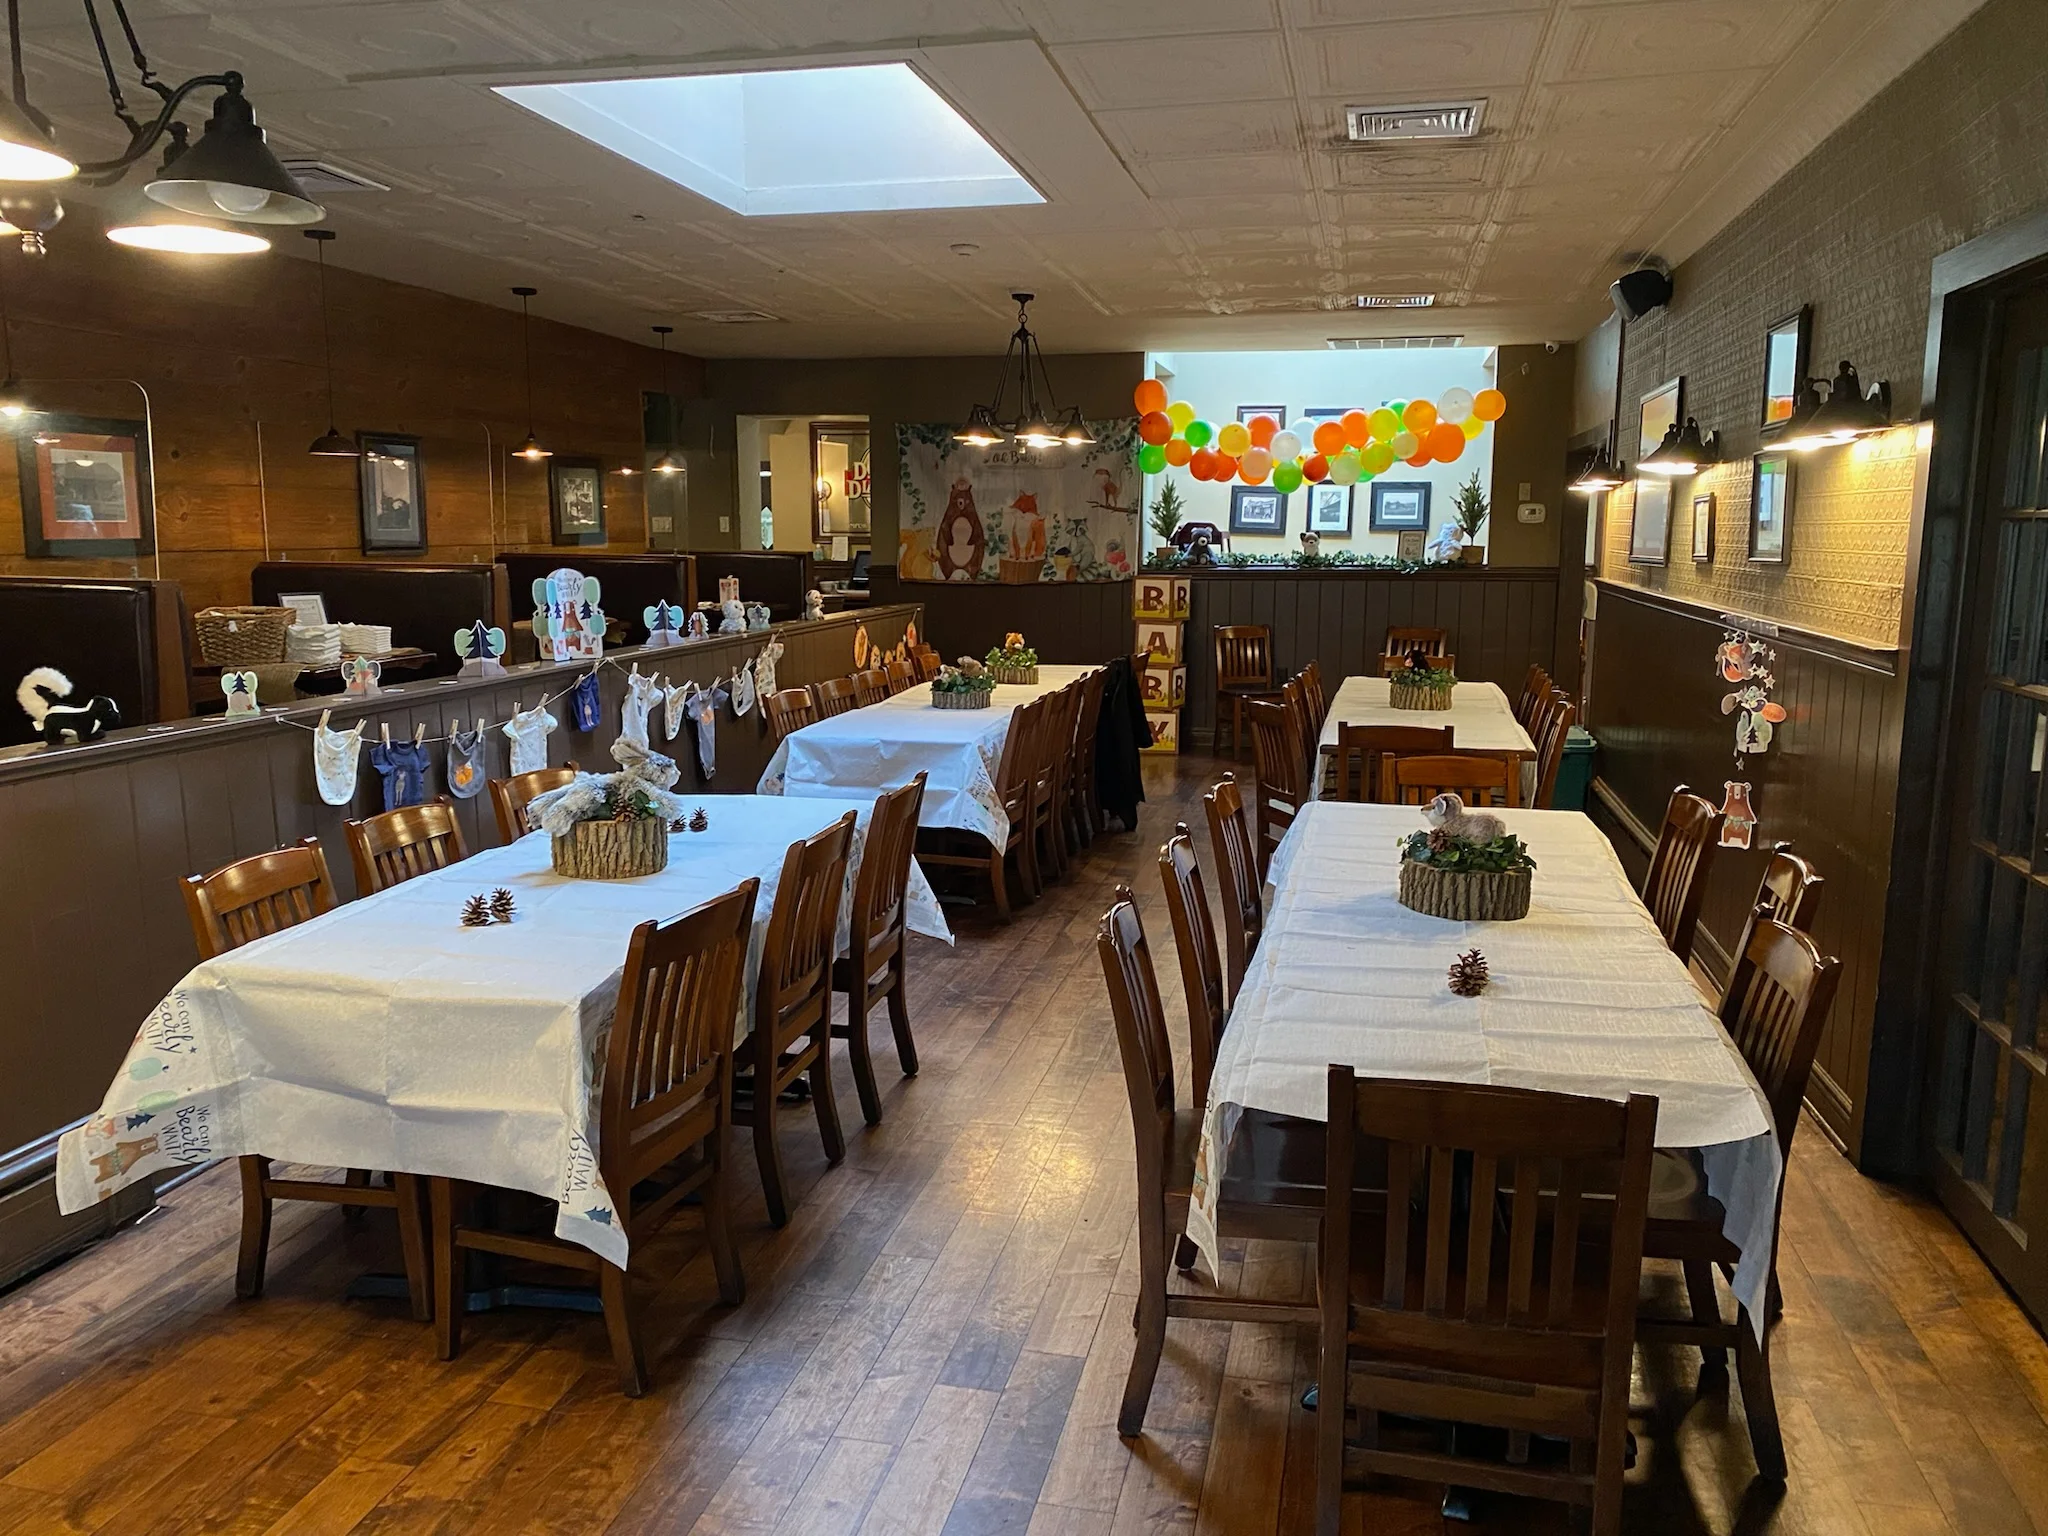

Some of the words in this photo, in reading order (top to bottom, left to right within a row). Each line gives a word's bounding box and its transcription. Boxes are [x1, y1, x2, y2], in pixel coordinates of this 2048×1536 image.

[155, 990, 194, 1054] early
[179, 1010, 192, 1034] can
[198, 1125, 210, 1147] can
